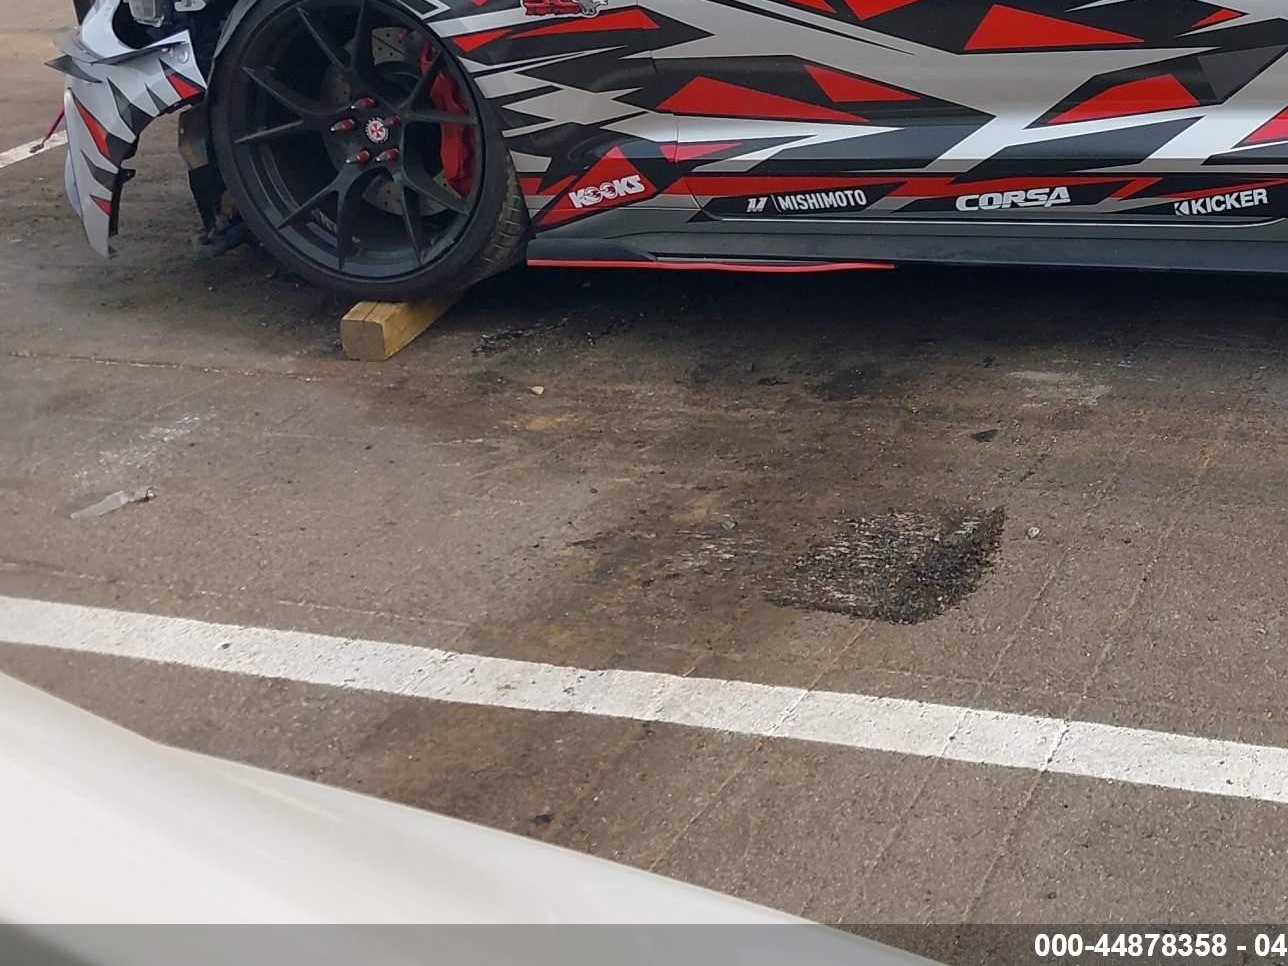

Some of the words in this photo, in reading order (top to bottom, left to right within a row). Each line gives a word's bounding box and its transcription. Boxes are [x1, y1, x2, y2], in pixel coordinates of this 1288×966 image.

[568, 174, 645, 208] KOOKS
[777, 189, 867, 211] MISHIMOTO
[956, 186, 1071, 211] CORSA
[1191, 188, 1268, 214] KICKER
